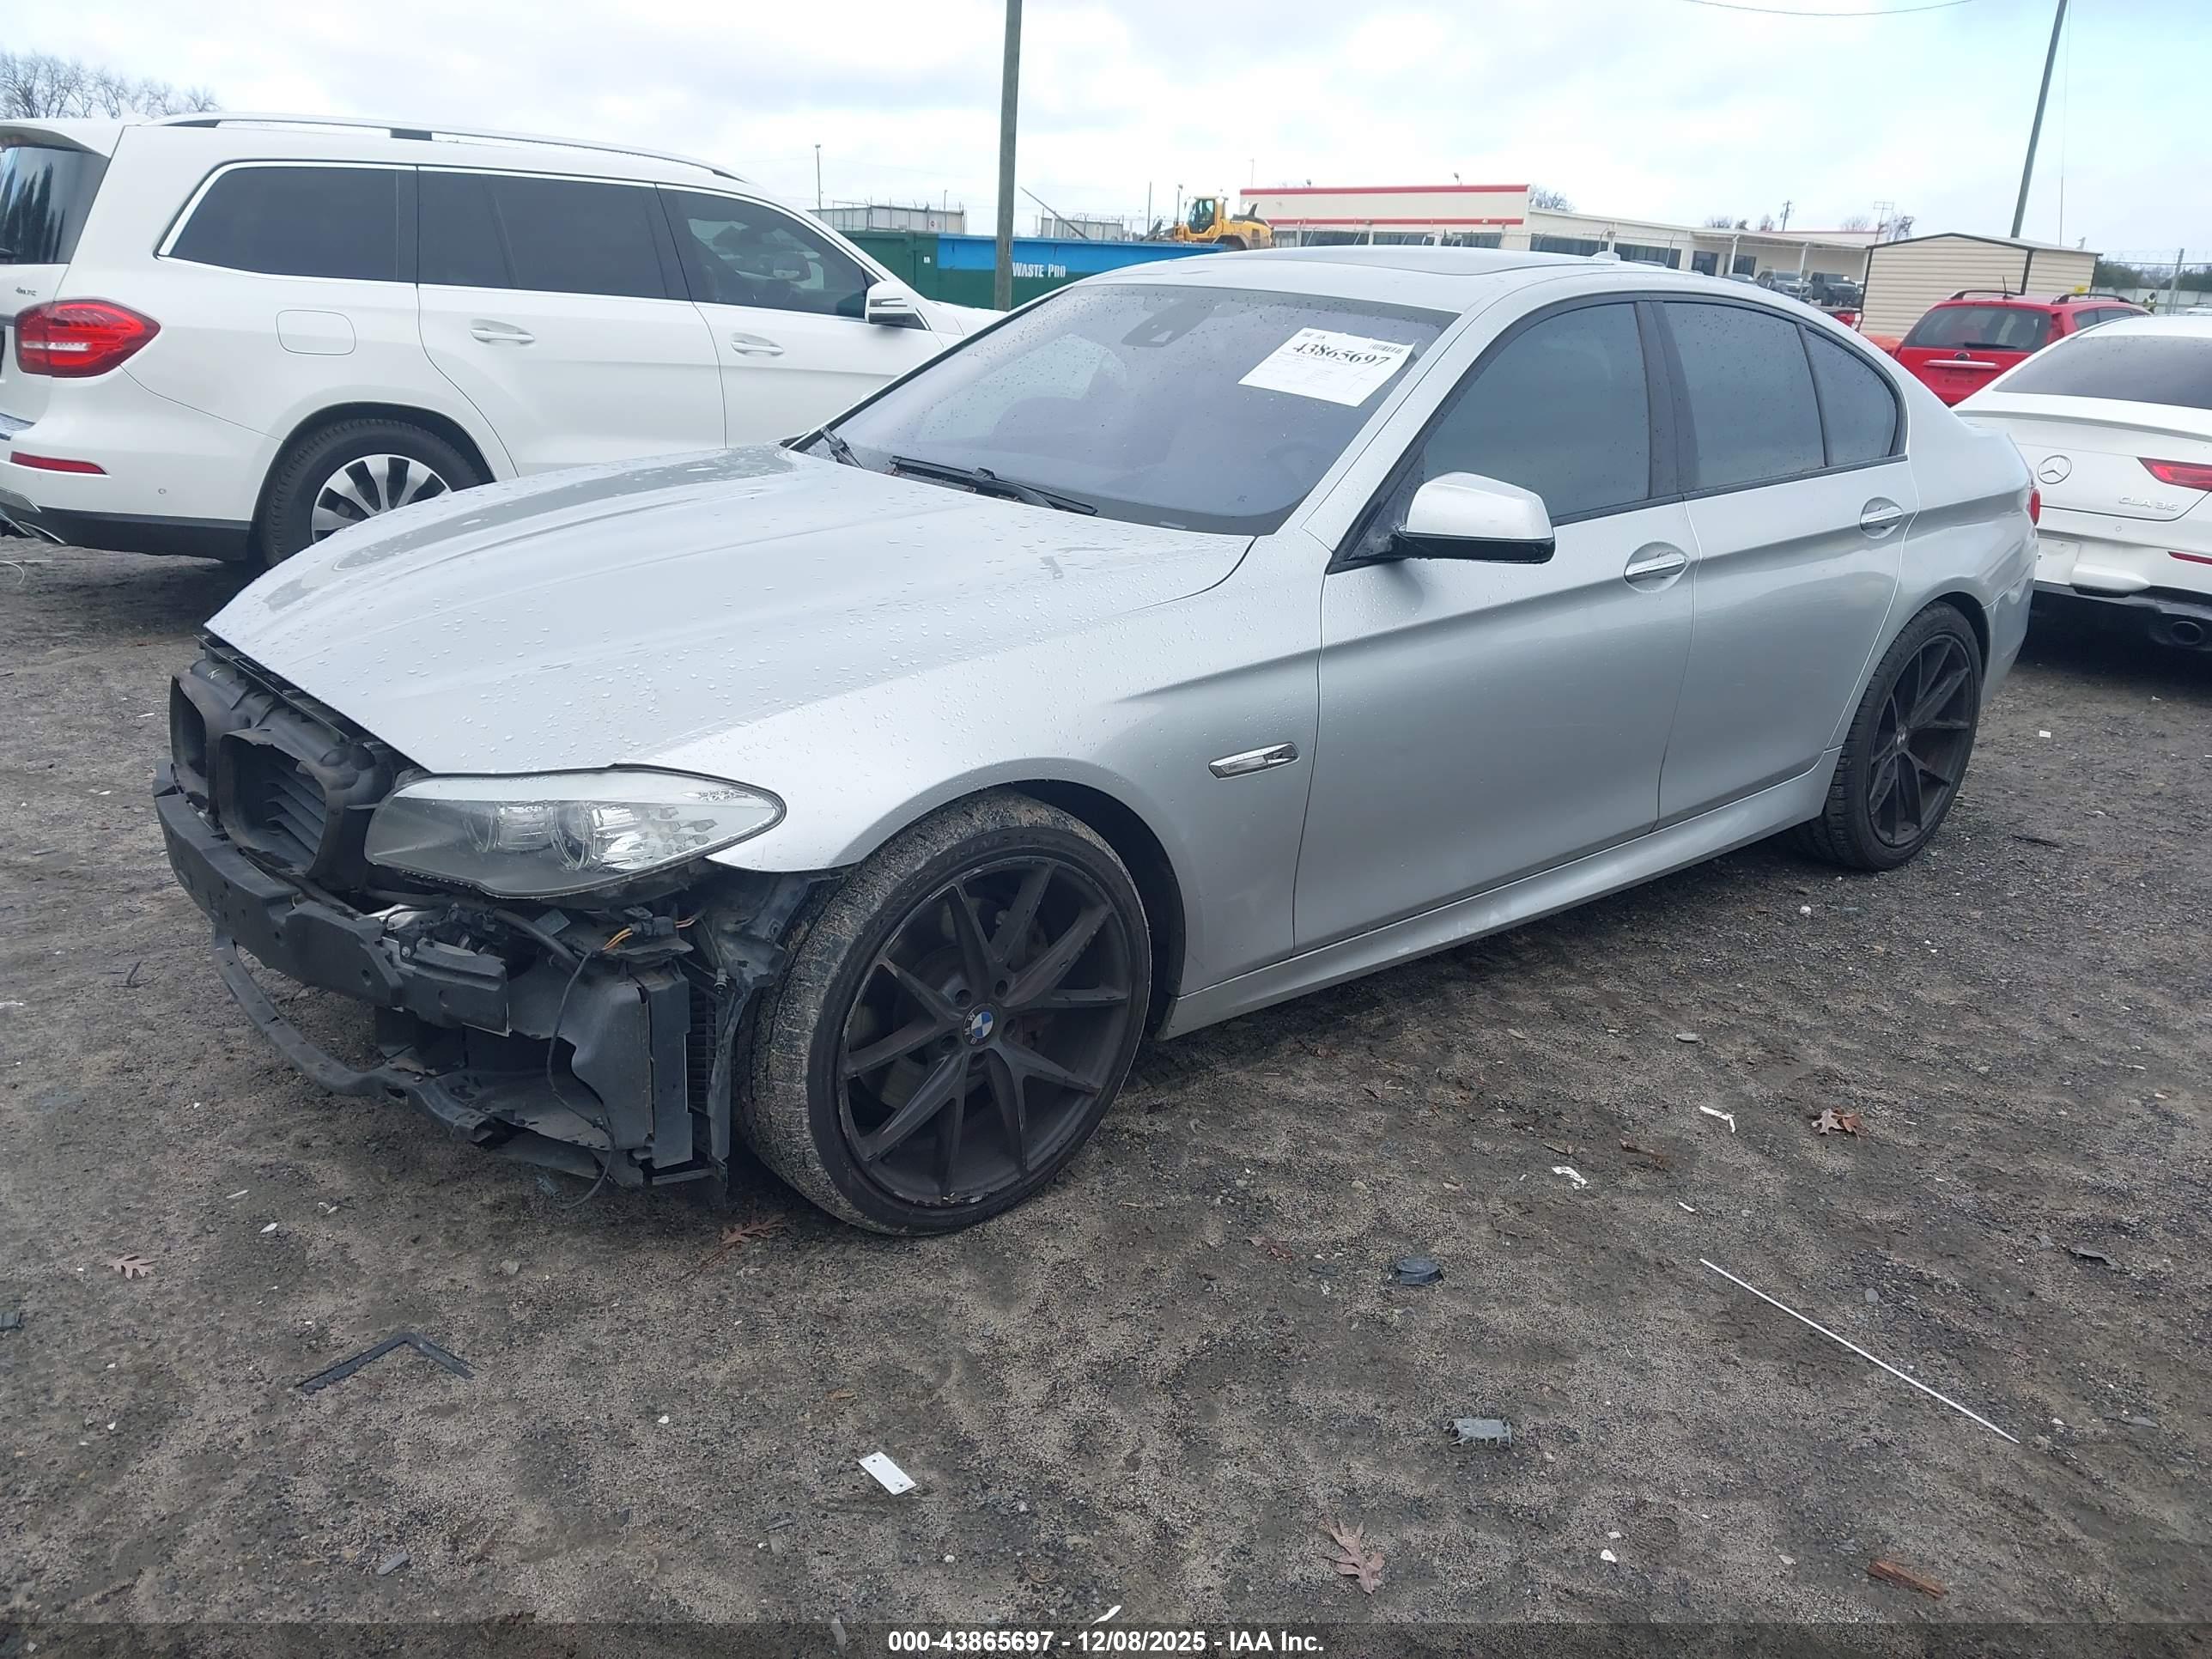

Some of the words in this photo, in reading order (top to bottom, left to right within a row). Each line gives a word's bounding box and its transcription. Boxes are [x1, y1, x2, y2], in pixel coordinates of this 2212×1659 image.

[1012, 262, 1044, 277] WASTE
[1292, 342, 1391, 368] 43865697
[2118, 495, 2152, 508] CLA
[2155, 501, 2179, 512] 35
